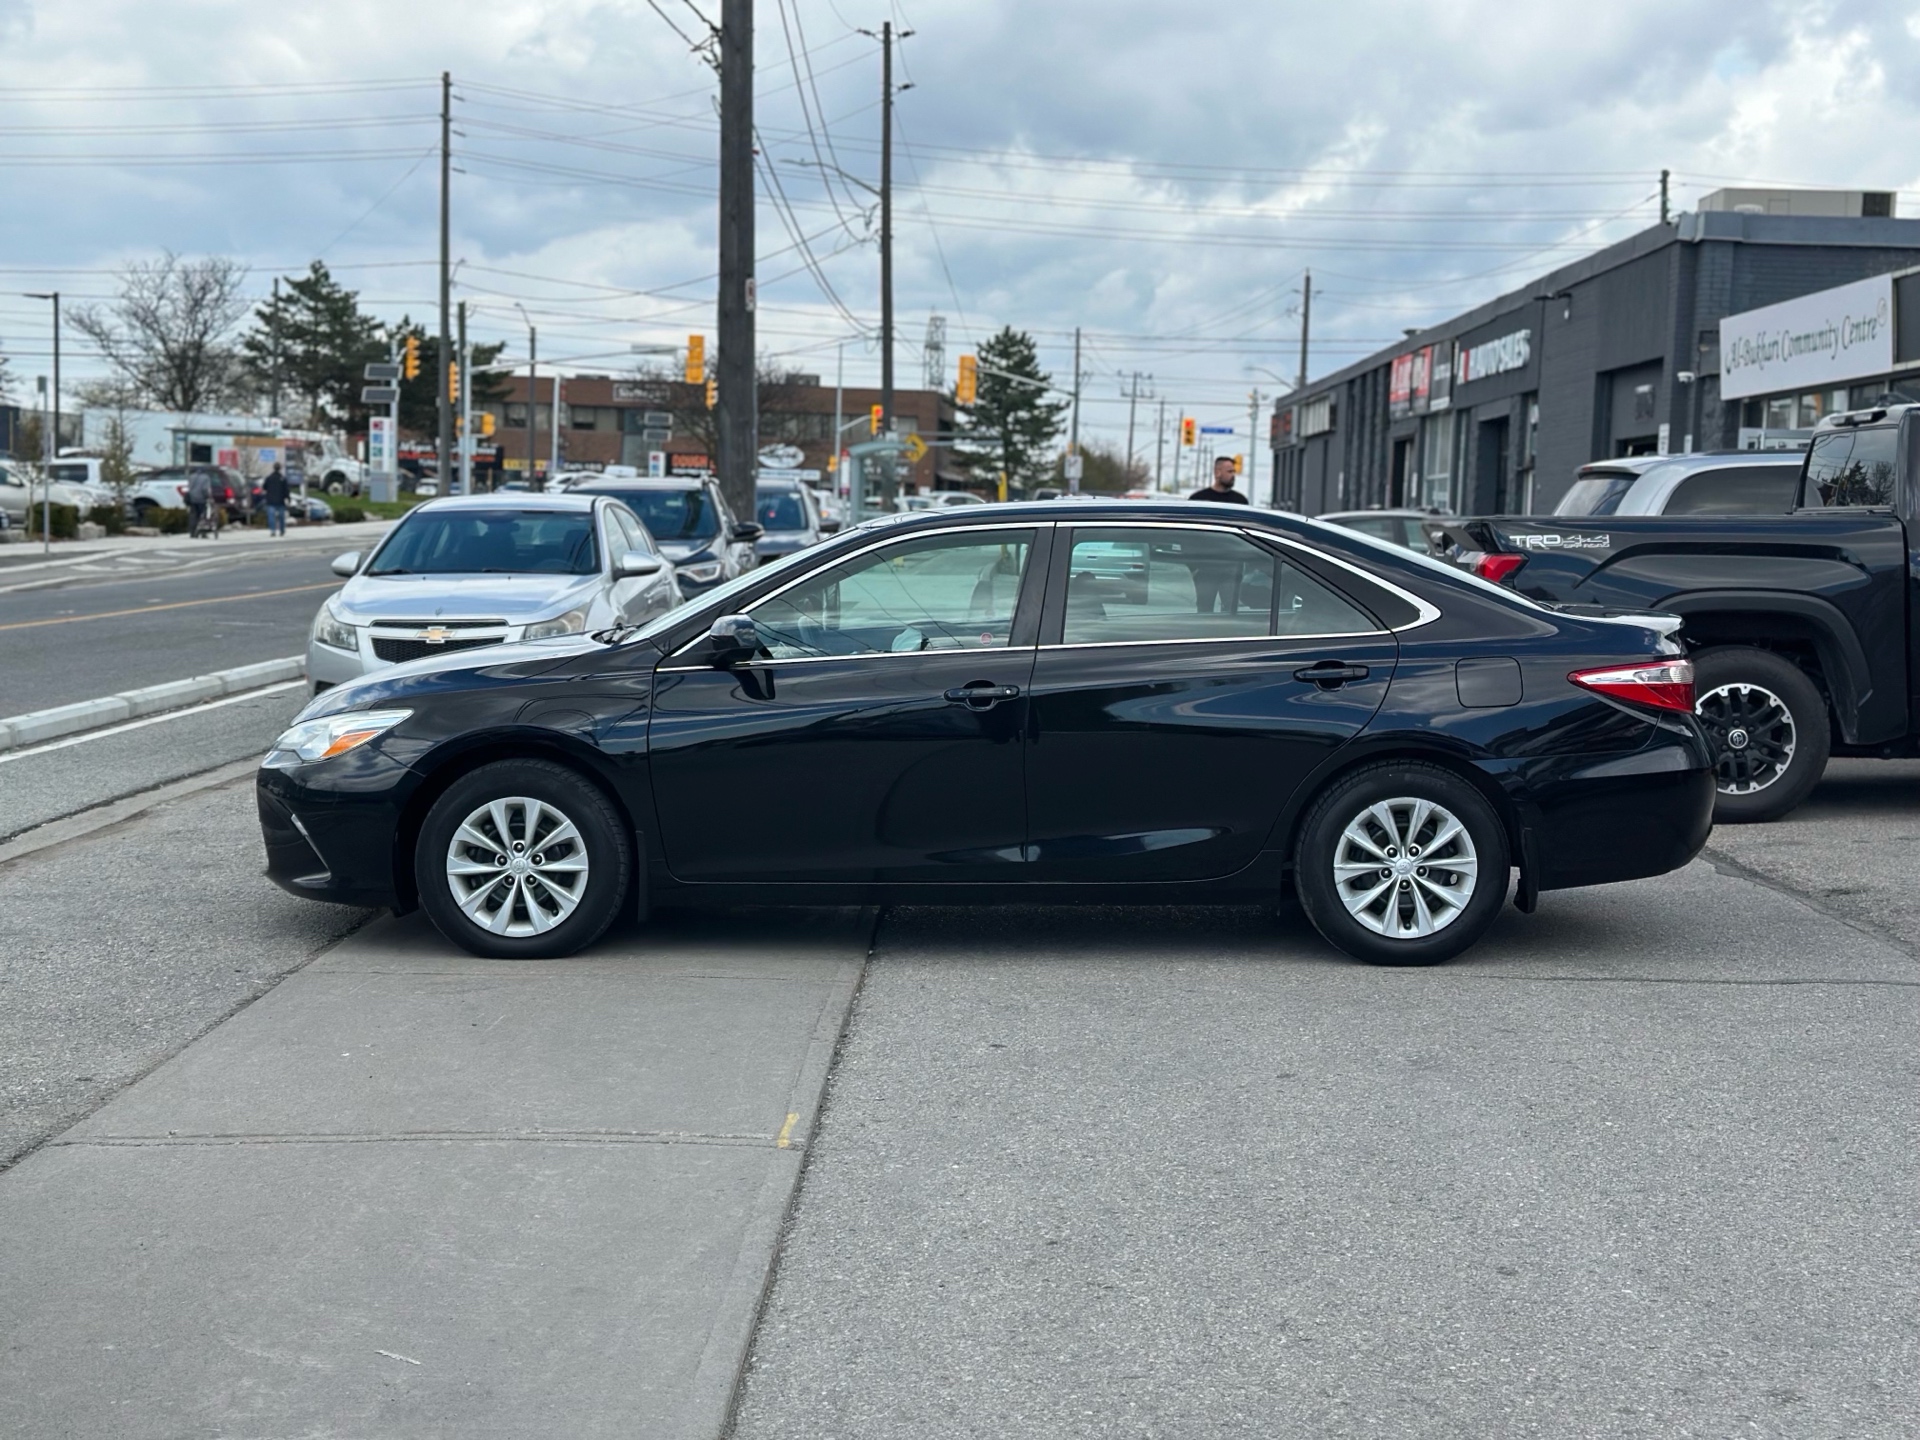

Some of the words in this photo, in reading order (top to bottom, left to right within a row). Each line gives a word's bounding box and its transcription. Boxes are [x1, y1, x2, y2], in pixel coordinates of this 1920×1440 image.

[1725, 331, 1780, 375] Al-Bukhari
[1781, 319, 1839, 362] Community
[1841, 315, 1878, 350] Centre
[1509, 534, 1562, 550] TRD
